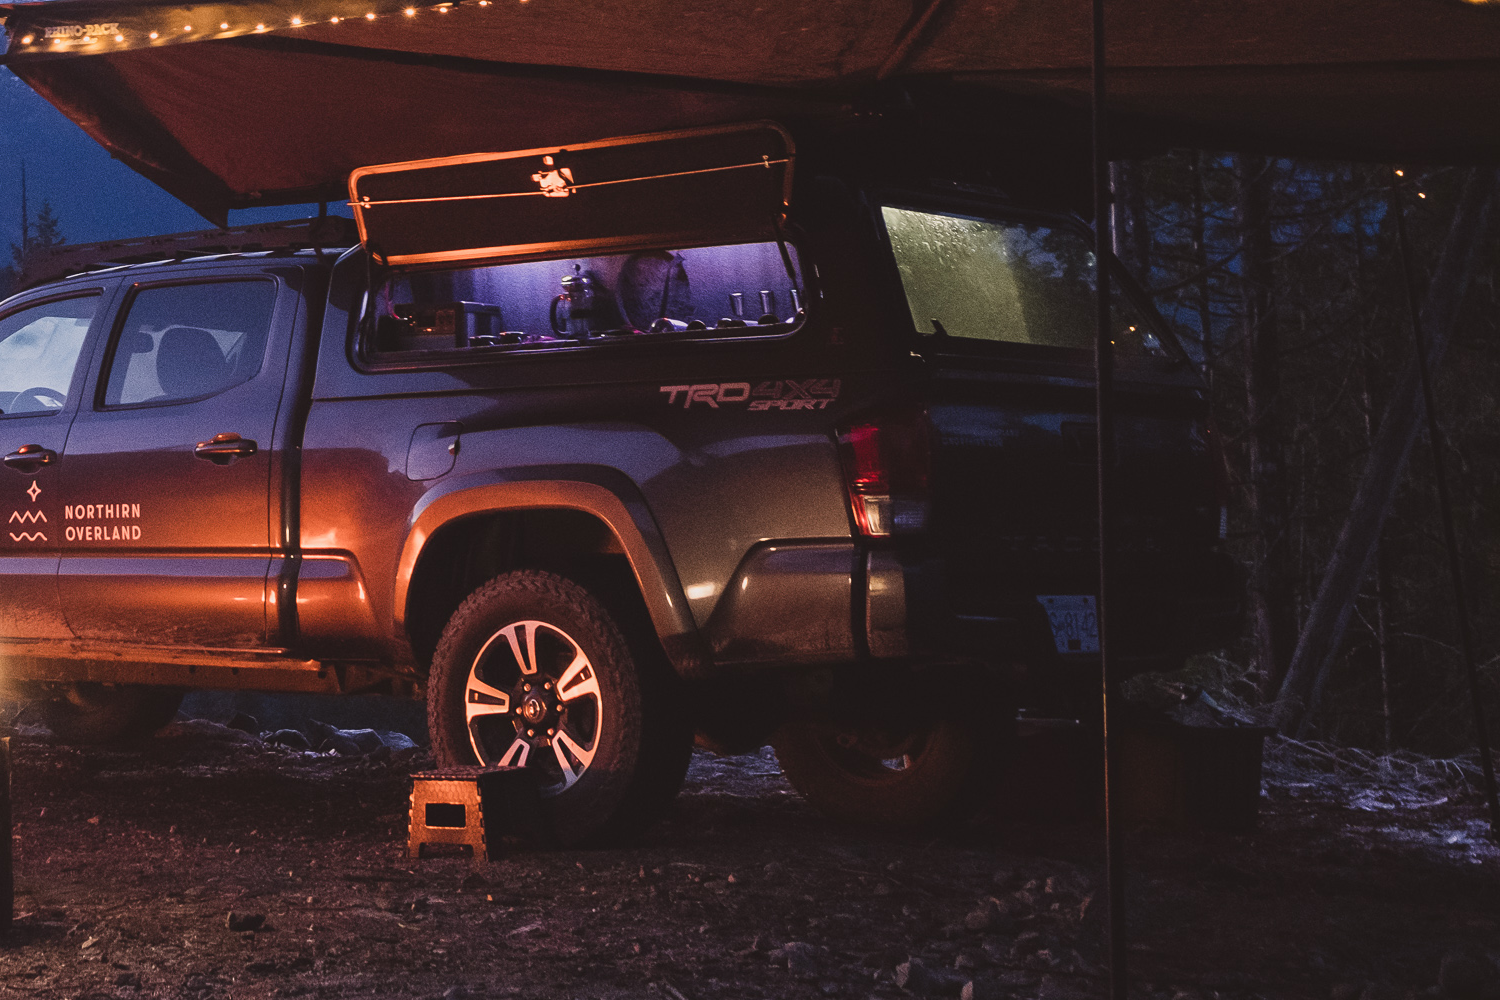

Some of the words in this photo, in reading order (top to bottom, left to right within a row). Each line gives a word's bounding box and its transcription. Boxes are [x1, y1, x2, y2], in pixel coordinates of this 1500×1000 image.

[44, 22, 120, 38] RHINO-RACK
[659, 382, 750, 409] TRD
[750, 378, 842, 401] 4X4
[746, 398, 836, 411] SPORT
[64, 503, 141, 520] NORTHIRN
[65, 525, 142, 541] OVERLAND
